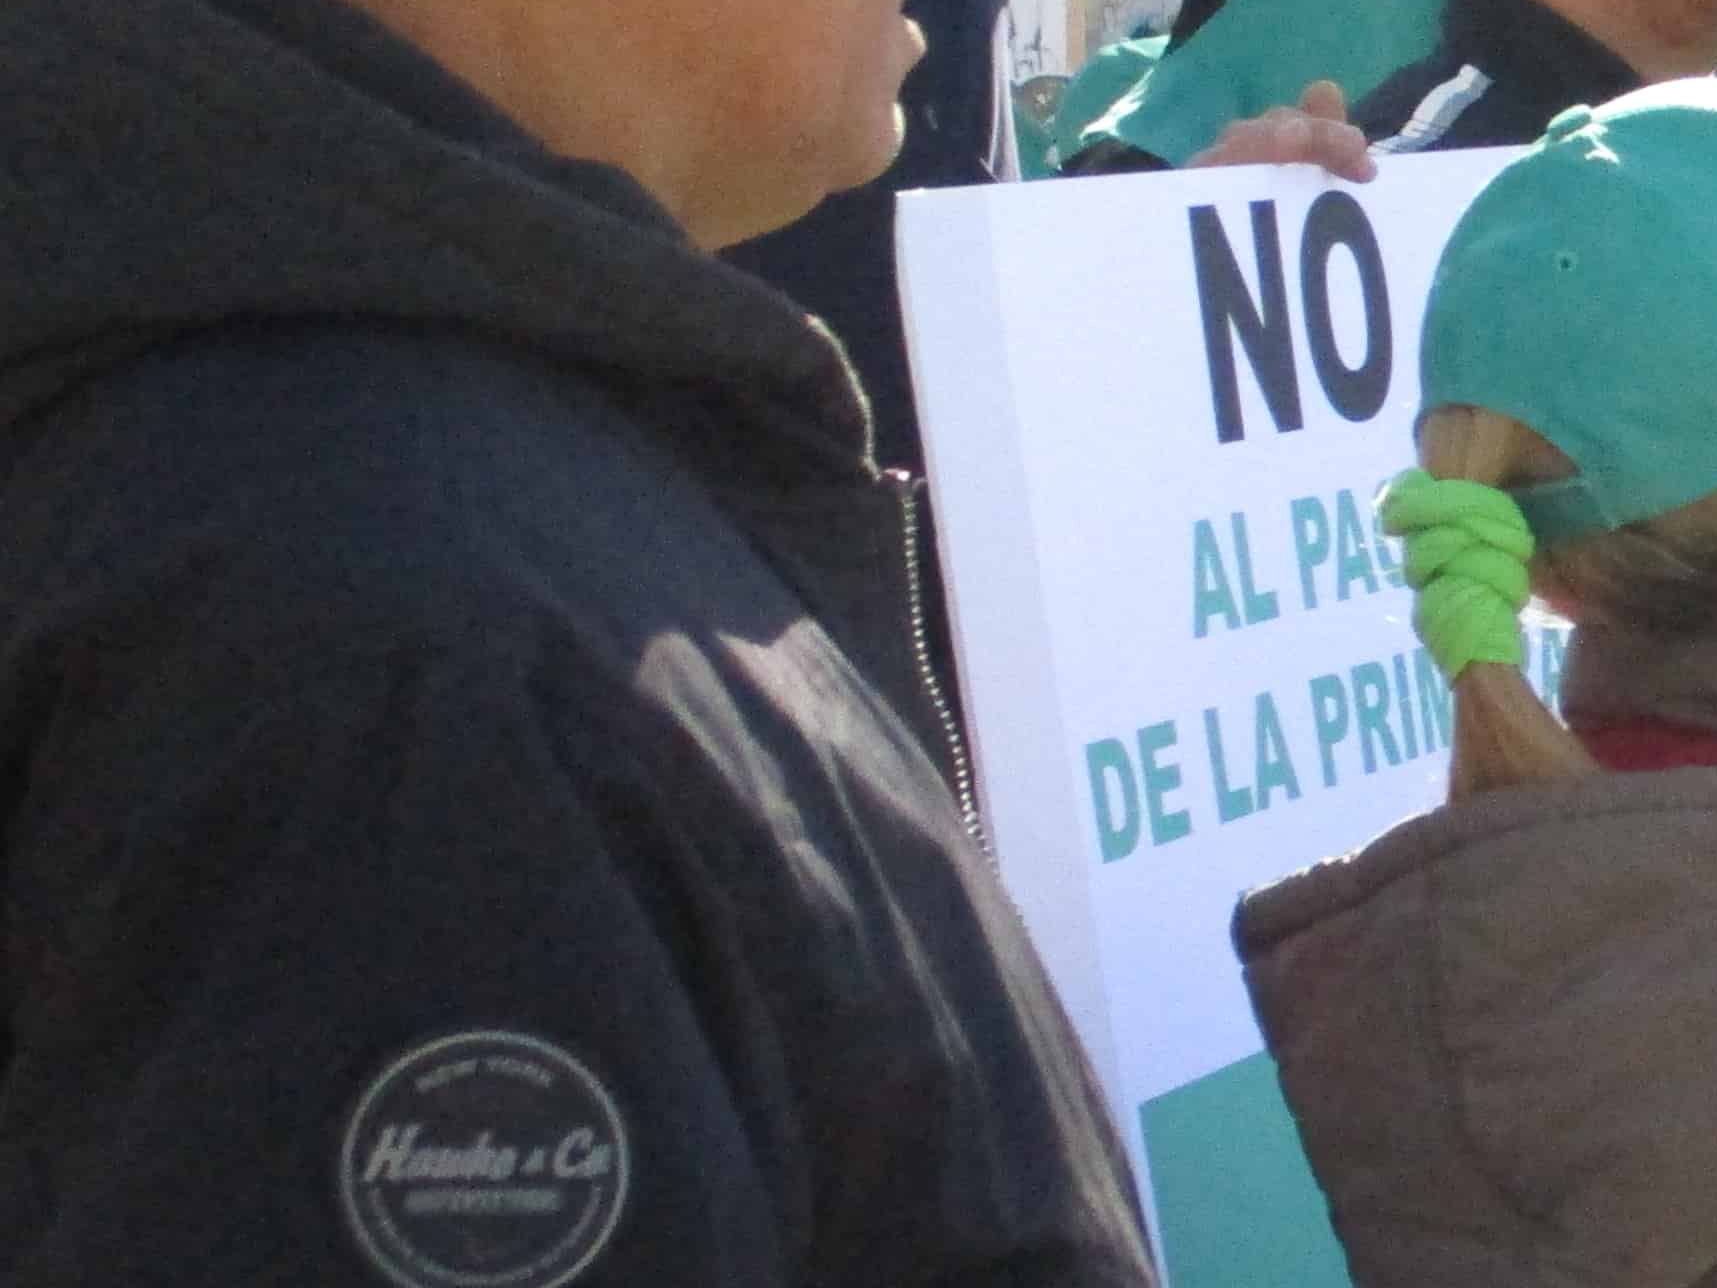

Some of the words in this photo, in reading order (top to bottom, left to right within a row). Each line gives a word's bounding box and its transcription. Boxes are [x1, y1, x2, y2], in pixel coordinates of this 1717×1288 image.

[1188, 190, 1394, 444] NO
[1191, 511, 1280, 640] AL
[1084, 719, 1192, 866] DE
[1205, 691, 1301, 825] LA
